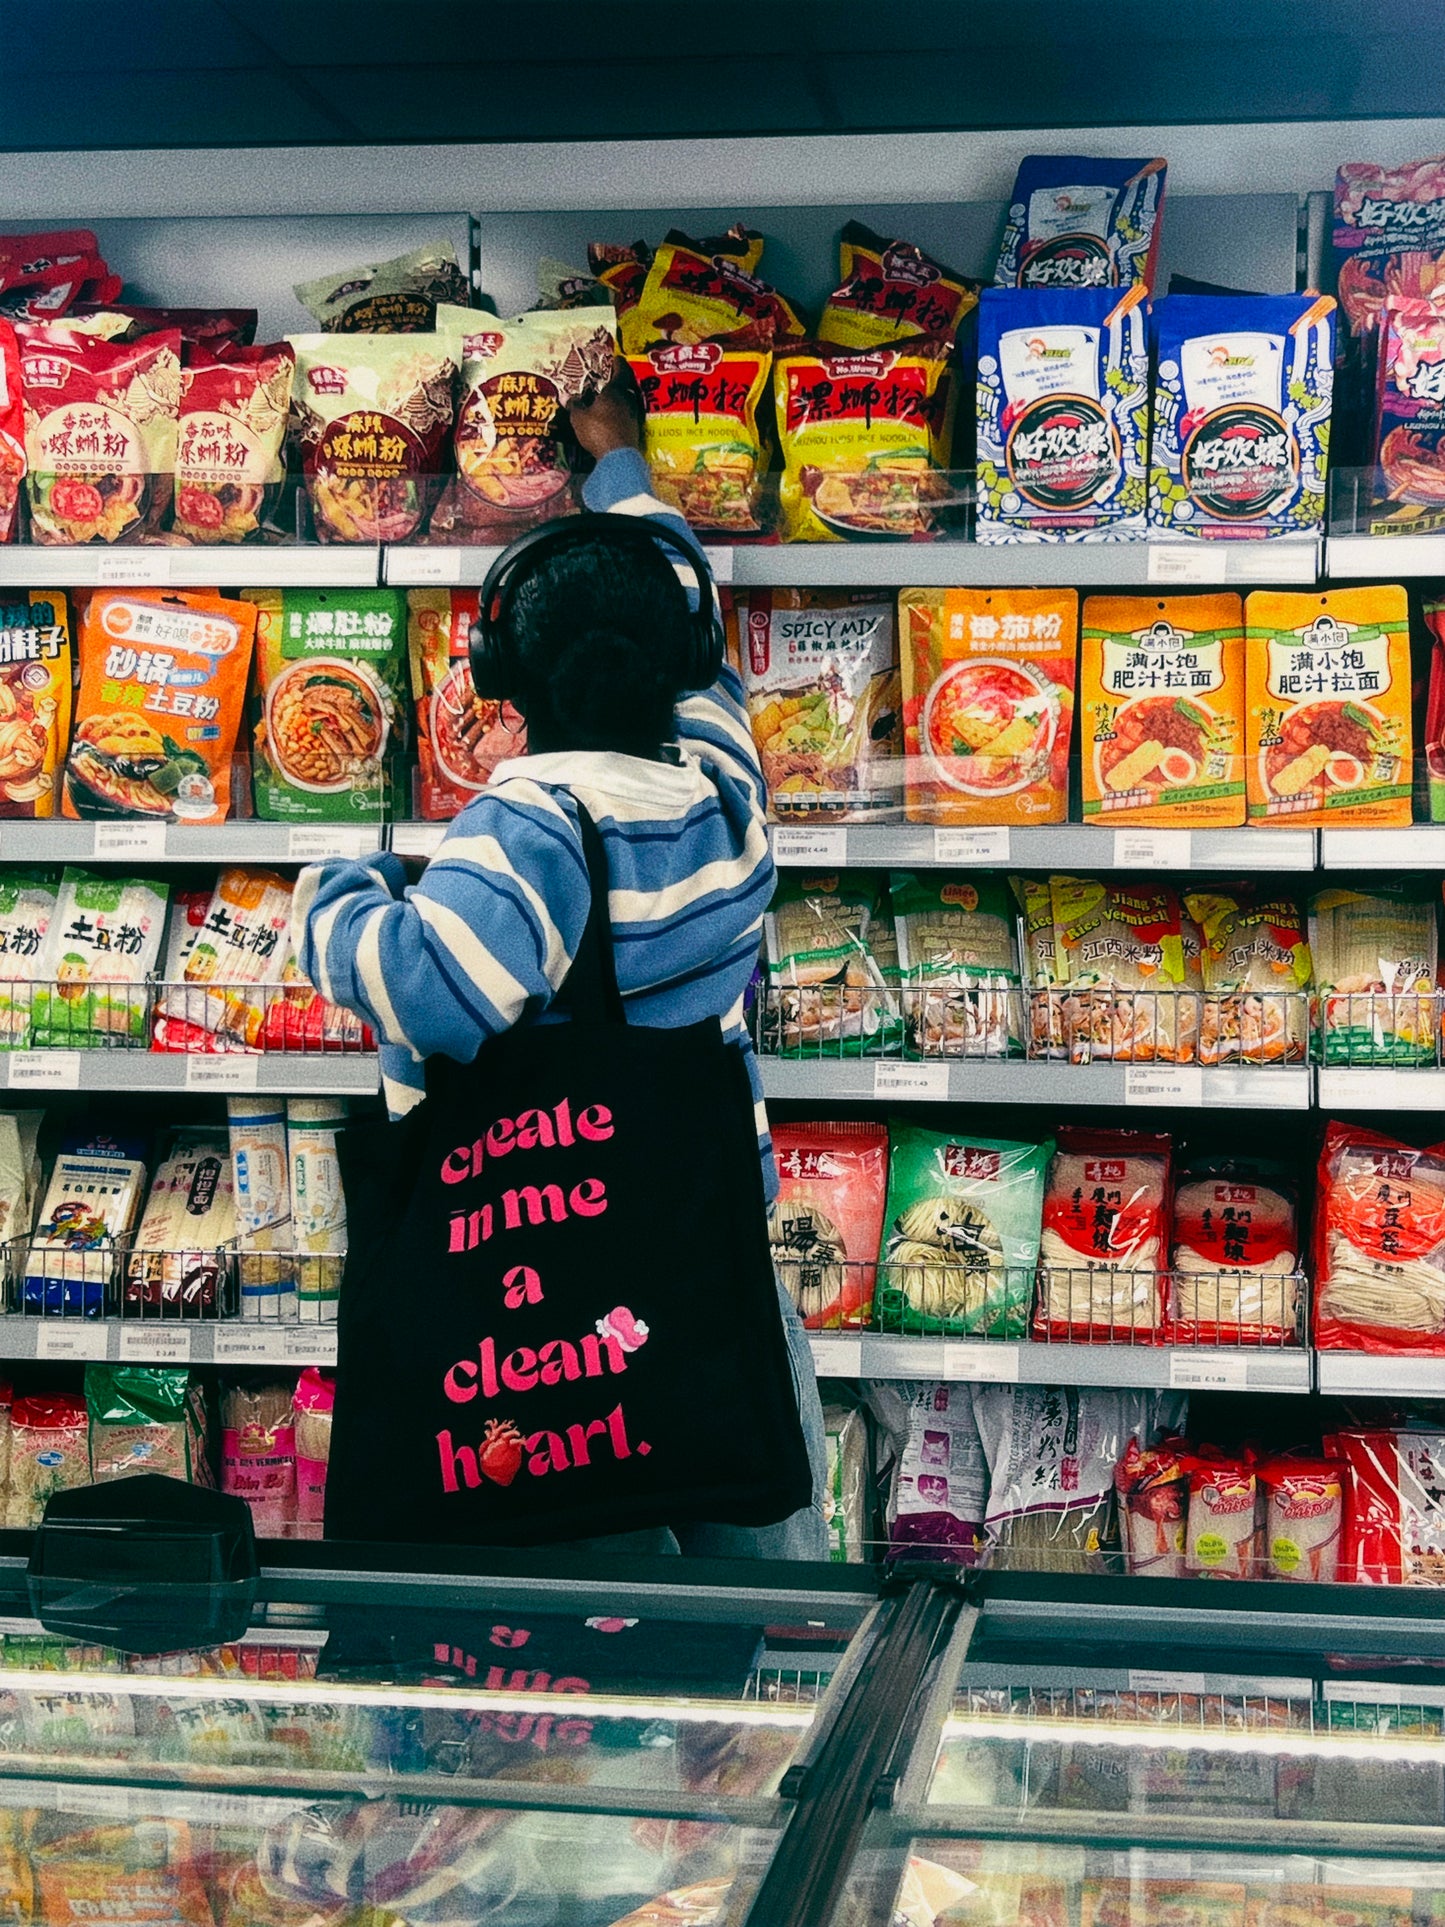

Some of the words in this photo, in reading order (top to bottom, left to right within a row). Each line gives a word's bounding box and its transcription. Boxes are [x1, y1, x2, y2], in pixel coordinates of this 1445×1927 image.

[61, 411, 112, 431] 番茄味
[791, 380, 938, 431] 螺蛳粉
[184, 420, 234, 440] 番茄味
[1012, 421, 1110, 461] 好欢螺
[48, 432, 130, 460] 螺蛳粉
[1188, 434, 1288, 471] 好欢螺
[781, 620, 837, 639] SPICY
[840, 616, 879, 637] MIX
[969, 613, 1063, 640] 番茄粉
[105, 645, 176, 686] 砂锅
[1125, 652, 1200, 670] 满小饱
[1290, 649, 1366, 672] 满小饱
[1112, 669, 1213, 689] 肥汁拉面
[1278, 670, 1380, 695] 肥汁拉面
[144, 687, 222, 721] 土豆粉
[1111, 892, 1150, 912] Jiang
[64, 914, 146, 955] 土豆粉
[205, 907, 279, 958] 土豆粉
[1065, 918, 1101, 941] Rice
[1082, 937, 1165, 964] 江西米粉
[440, 1096, 615, 1185] create
[448, 1209, 494, 1254] in
[501, 1177, 608, 1230] me
[502, 1265, 544, 1310] a
[443, 1334, 628, 1404] clean
[435, 1402, 652, 1493] hart.
